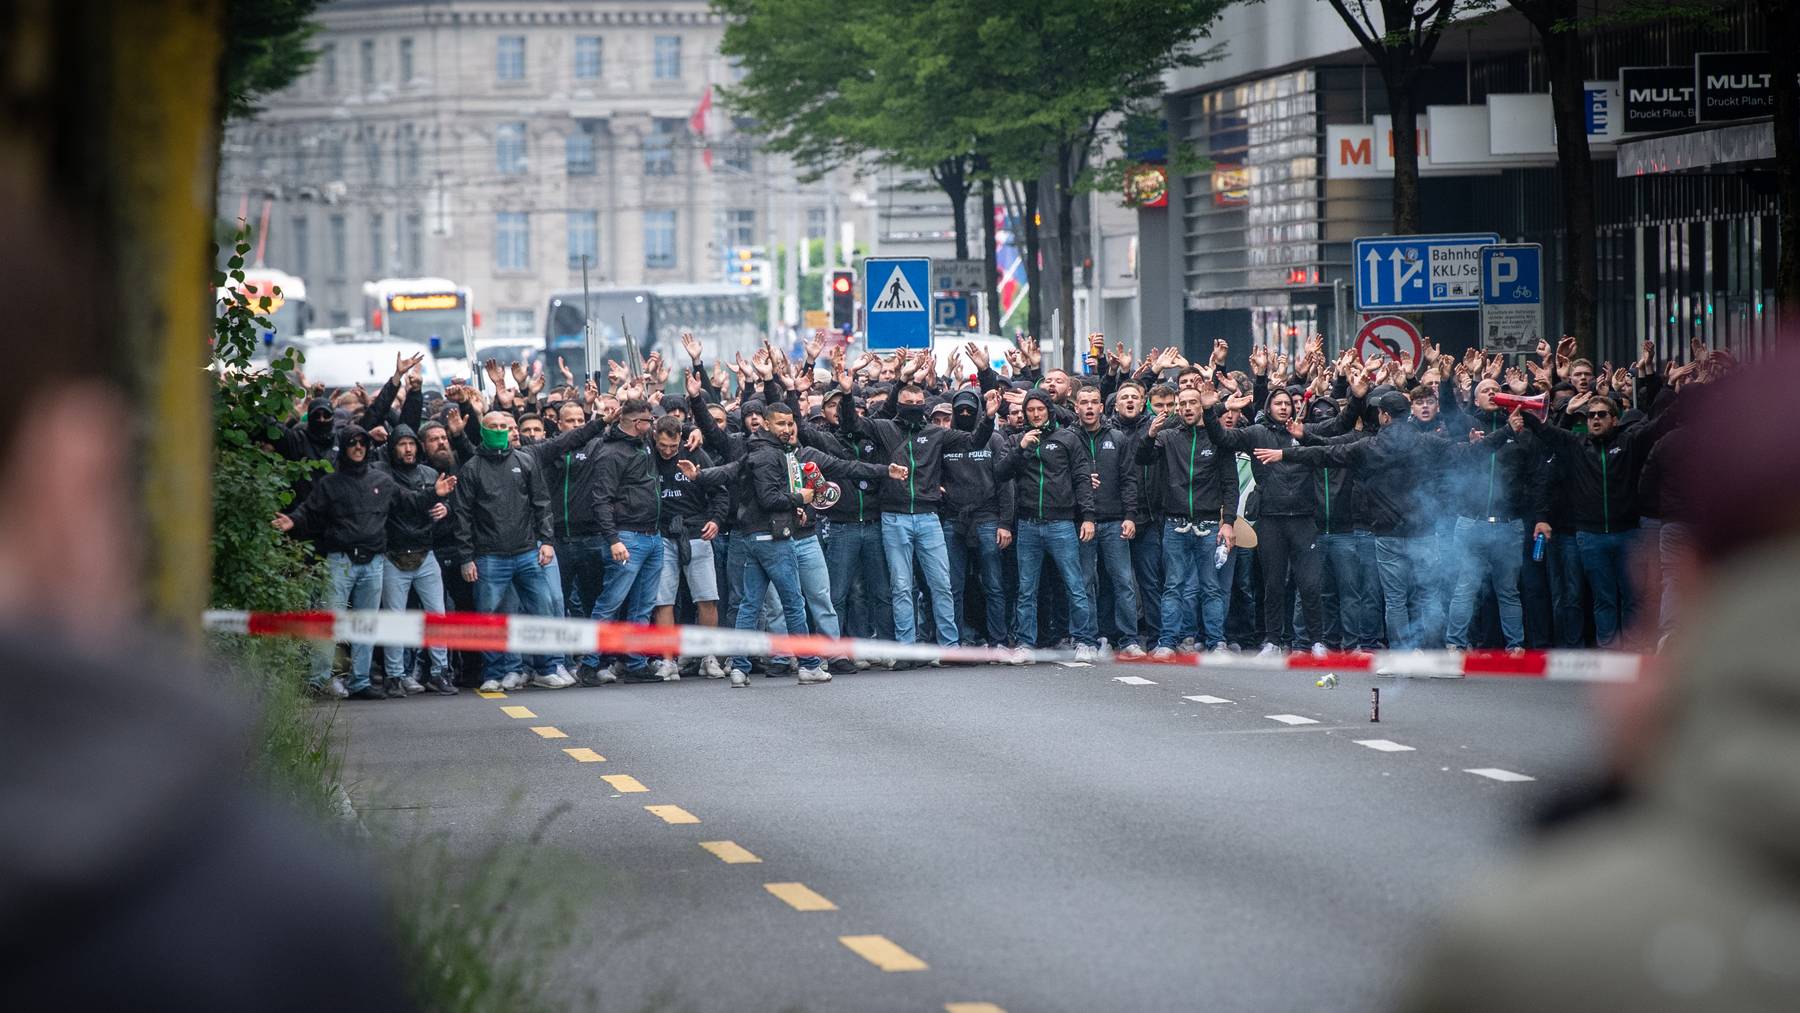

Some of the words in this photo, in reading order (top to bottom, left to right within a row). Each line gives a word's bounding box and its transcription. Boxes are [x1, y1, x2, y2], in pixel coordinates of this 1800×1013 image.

[1707, 74, 1772, 89] MULT
[1630, 87, 1694, 103] MULT
[1707, 97, 1739, 107] Druckt
[1742, 96, 1766, 106] Plan,
[1592, 91, 1608, 134] LUPK
[1630, 109, 1661, 120] Druckt
[1663, 109, 1687, 119] Plan,
[1432, 248, 1479, 261] Bahnho
[1433, 264, 1477, 277] KKL/Se
[1491, 256, 1518, 297] P
[939, 301, 956, 325] P
